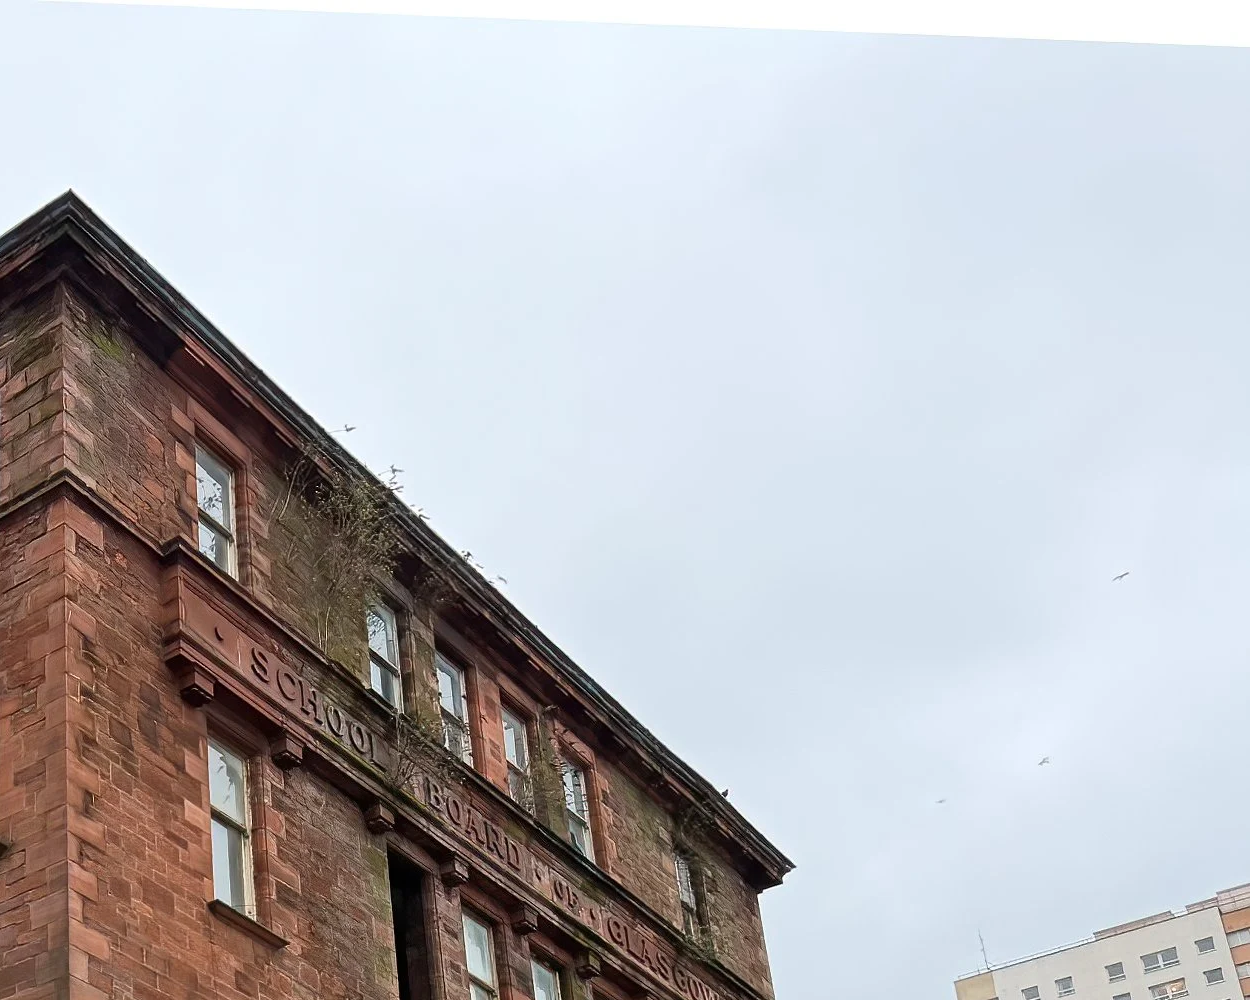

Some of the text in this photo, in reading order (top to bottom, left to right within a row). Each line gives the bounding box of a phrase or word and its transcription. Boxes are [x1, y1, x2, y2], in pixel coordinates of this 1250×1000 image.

[251, 647, 386, 773] SCHOOL
[424, 776, 521, 872] BOARD
[553, 879, 579, 909] OF
